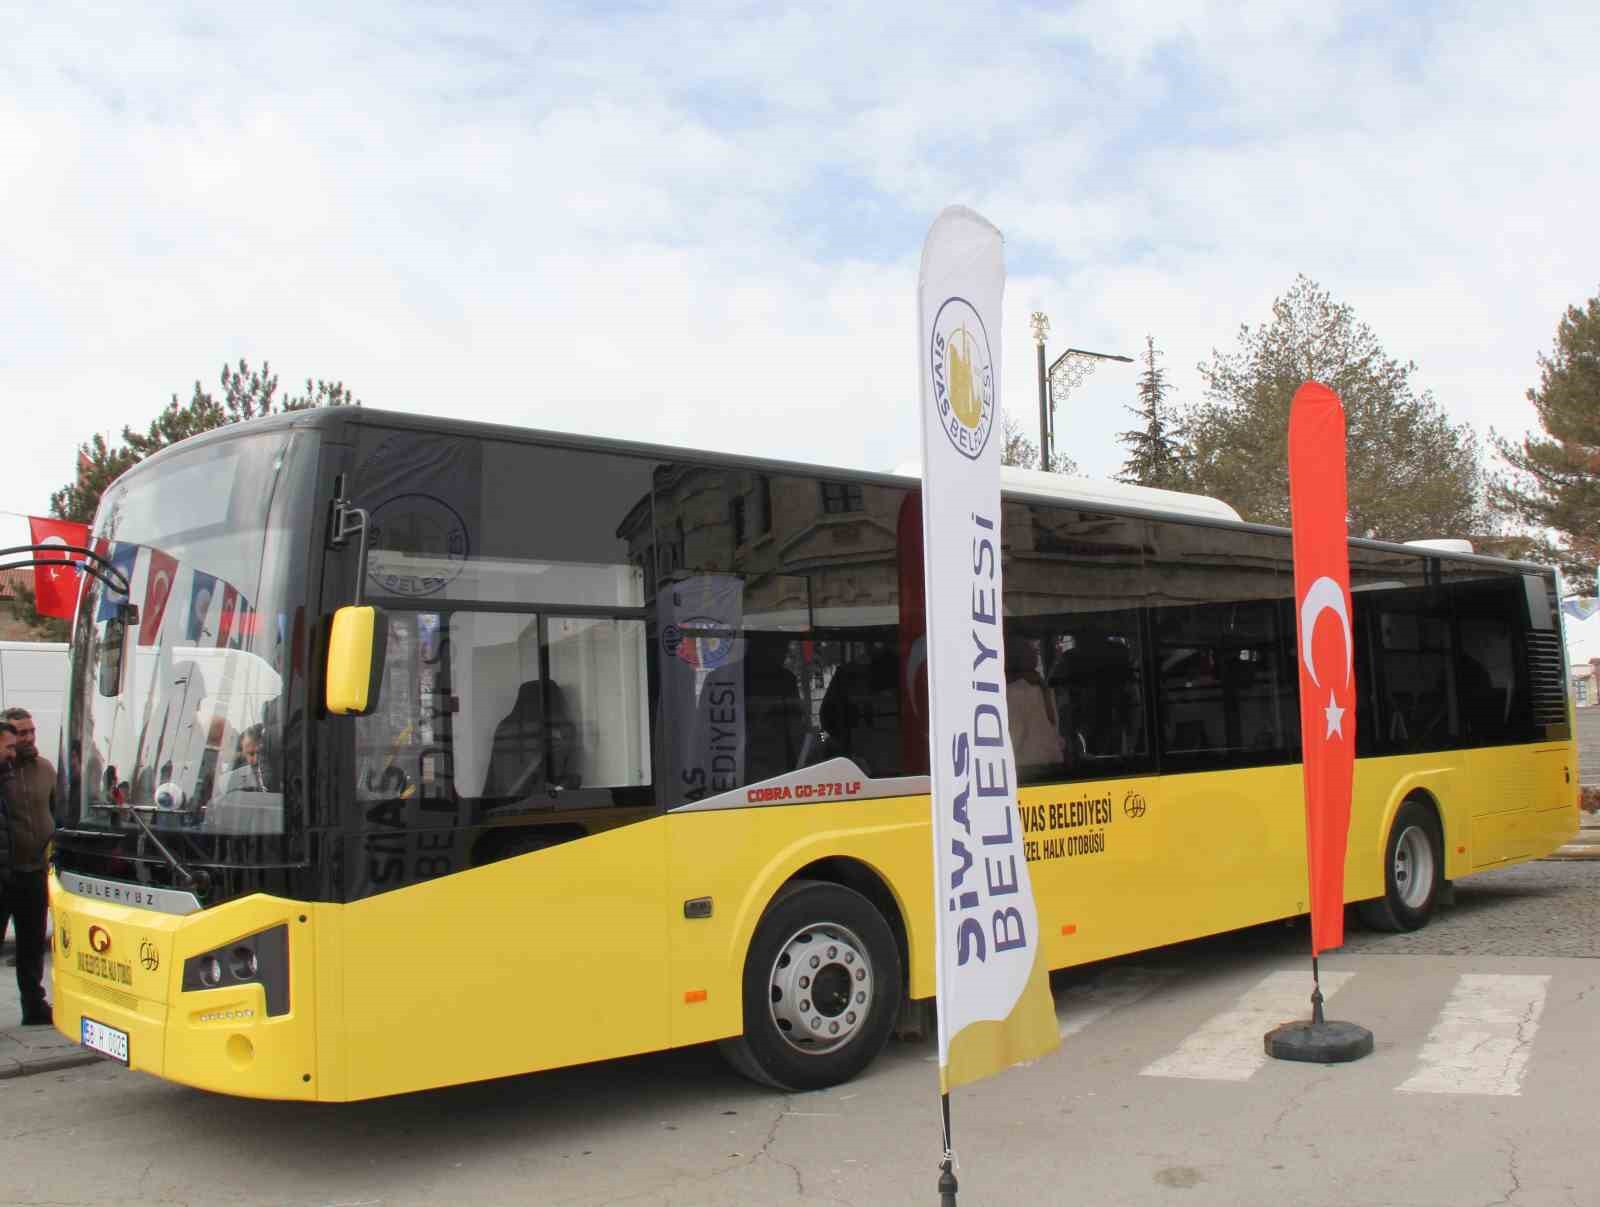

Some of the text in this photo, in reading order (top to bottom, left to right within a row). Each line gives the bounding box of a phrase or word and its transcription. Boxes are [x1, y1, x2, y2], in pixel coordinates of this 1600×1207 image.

[707, 681, 737, 791] EDİYESİ
[971, 512, 1027, 953] BELEDİYESİ
[747, 786, 792, 802] COBRA
[845, 781, 862, 795] LF
[1017, 792, 1112, 833] İVAS BELEDİYESİ
[949, 731, 986, 967] SİVAS
[1043, 836, 1066, 860] HALK
[1068, 827, 1105, 857] OTOBÜSÜ
